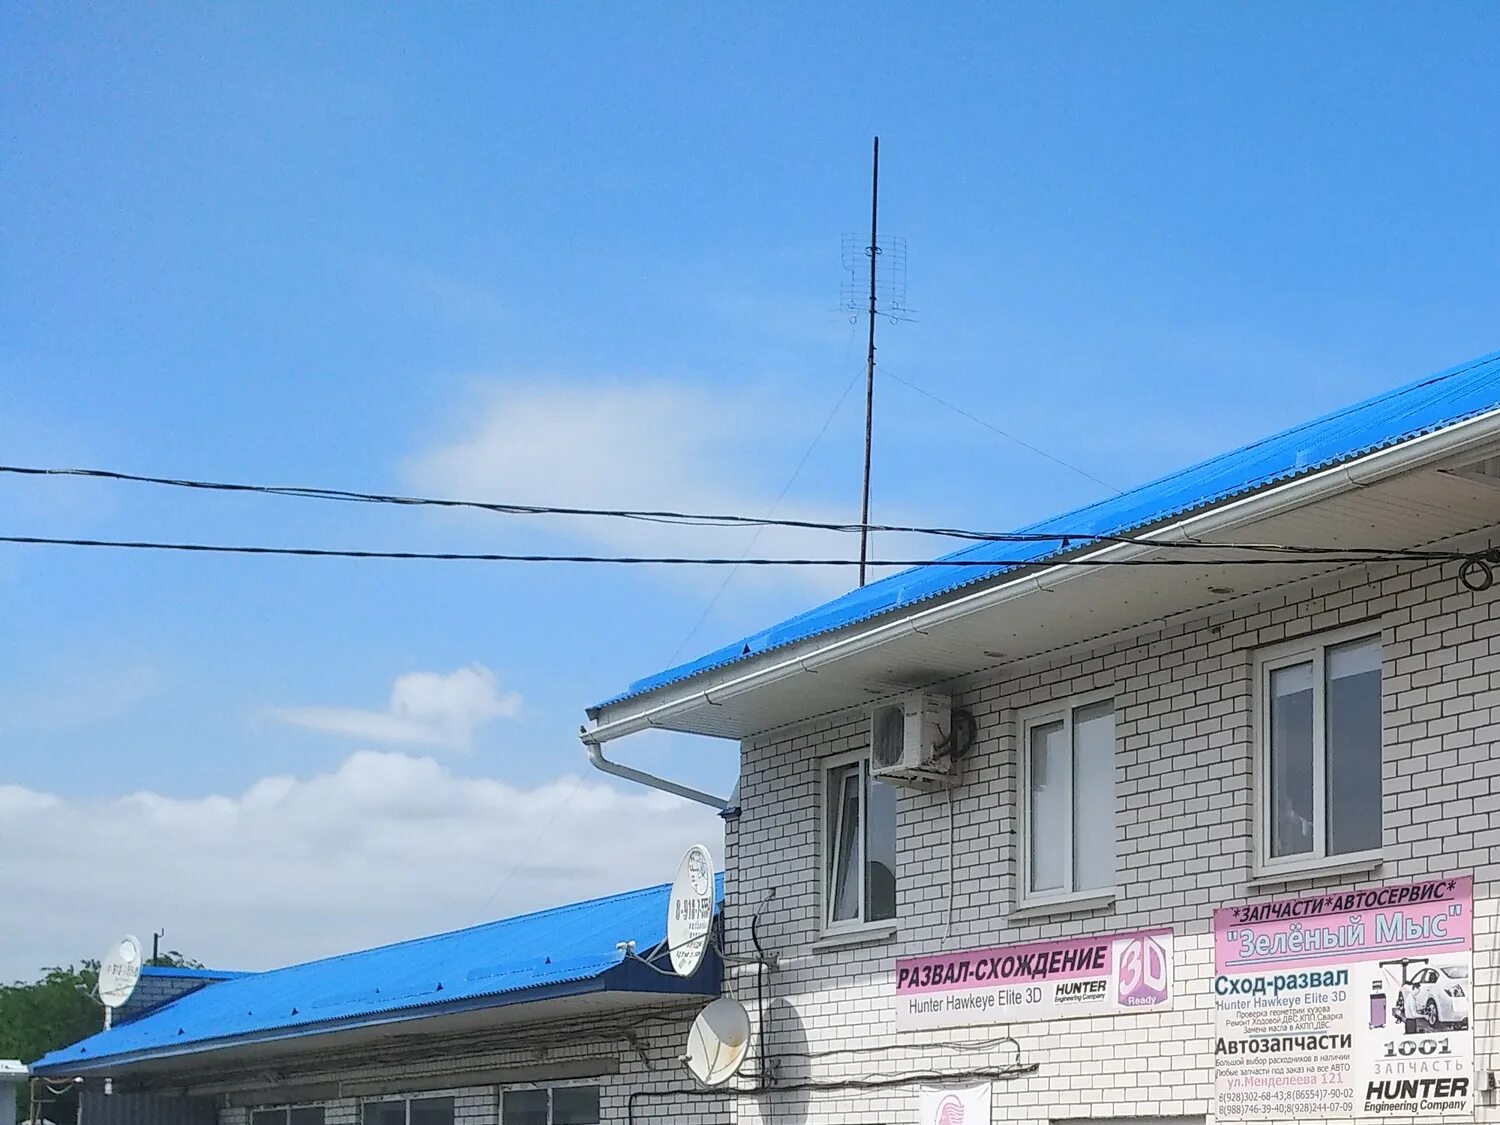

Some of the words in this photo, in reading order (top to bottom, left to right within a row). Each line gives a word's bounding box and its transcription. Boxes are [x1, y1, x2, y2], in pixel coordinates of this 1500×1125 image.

[1226, 915, 1364, 958] "Зелёный
[1376, 903, 1462, 944] Мыс"
[897, 945, 1108, 989] РАЗВАЛ-СХОЖДЕНИЕ
[1055, 980, 1107, 996] HUNTER
[1214, 969, 1349, 996] Сход-развал
[909, 998, 943, 1014] Hunter
[946, 993, 995, 1012] Hawkeye
[998, 989, 1022, 1006] Elite
[1025, 987, 1042, 1004] 3D
[1082, 993, 1106, 1002] Company
[1127, 995, 1157, 1006] Ready
[1216, 999, 1251, 1011] Hunter
[1253, 996, 1301, 1009] Hawkeye
[1304, 992, 1329, 1005] Elite
[1331, 990, 1347, 1002] 3D
[1225, 1019, 1251, 1027] Ремонт
[1236, 1010, 1268, 1019] Проверка
[1214, 1033, 1352, 1055] Автозапчасти
[1384, 1037, 1452, 1058] 1001
[1215, 1057, 1245, 1067] Большой
[1246, 1057, 1267, 1066] выбор
[1268, 1055, 1312, 1065] расходников
[1320, 1053, 1351, 1061] наличии
[1374, 1060, 1463, 1075] ЗАПЧАСТЬ
[1240, 1067, 1270, 1076] запчасти
[1271, 1067, 1285, 1075] под
[1286, 1066, 1305, 1074] заказ
[1306, 1065, 1315, 1073] на
[1316, 1064, 1329, 1072] все
[1330, 1063, 1351, 1072] АВТО
[1227, 1074, 1317, 1090] ул.Менделеева
[1321, 1072, 1344, 1084] 121
[1366, 1077, 1470, 1100] HUNTER
[1364, 1100, 1418, 1113] Engineering
[1419, 1099, 1467, 1111] Company
